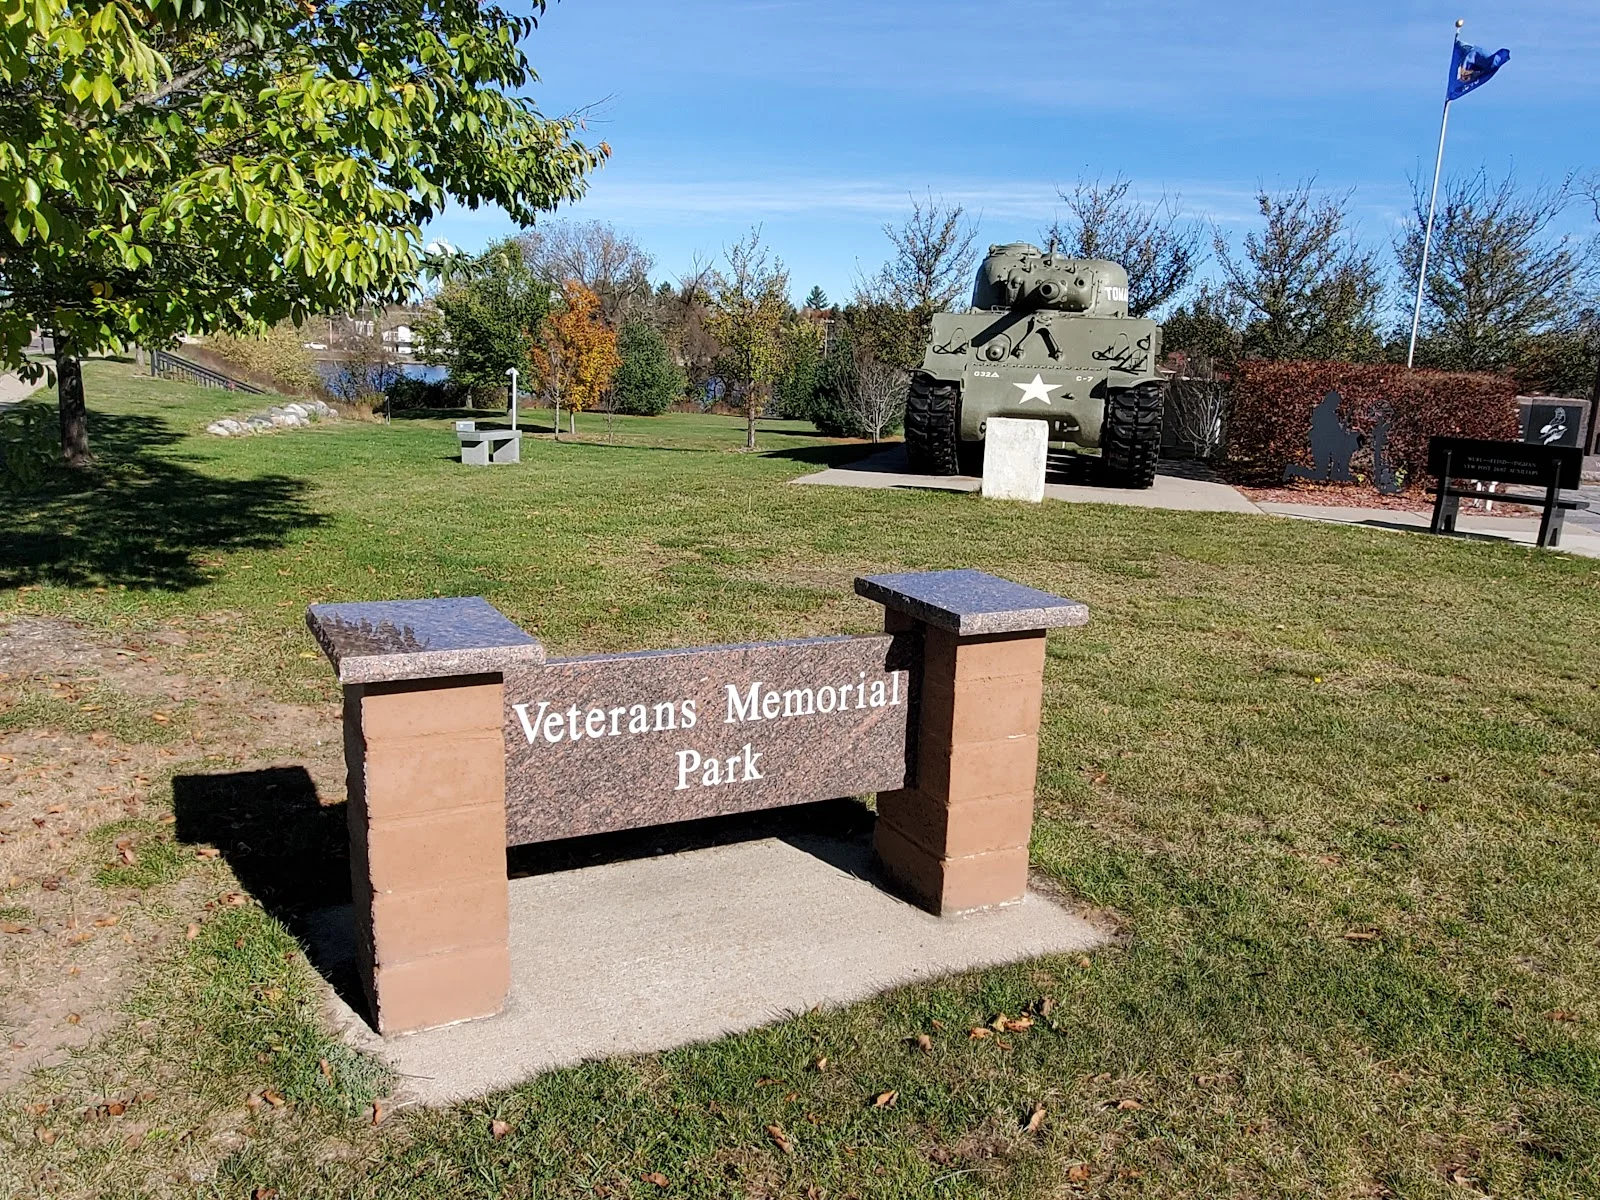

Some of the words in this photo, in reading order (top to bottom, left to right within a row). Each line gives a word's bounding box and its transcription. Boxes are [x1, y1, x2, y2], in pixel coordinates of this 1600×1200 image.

[1076, 375, 1094, 383] C-7
[512, 699, 697, 744] Veterans
[724, 669, 902, 724] Memorial
[674, 742, 764, 791] Park
